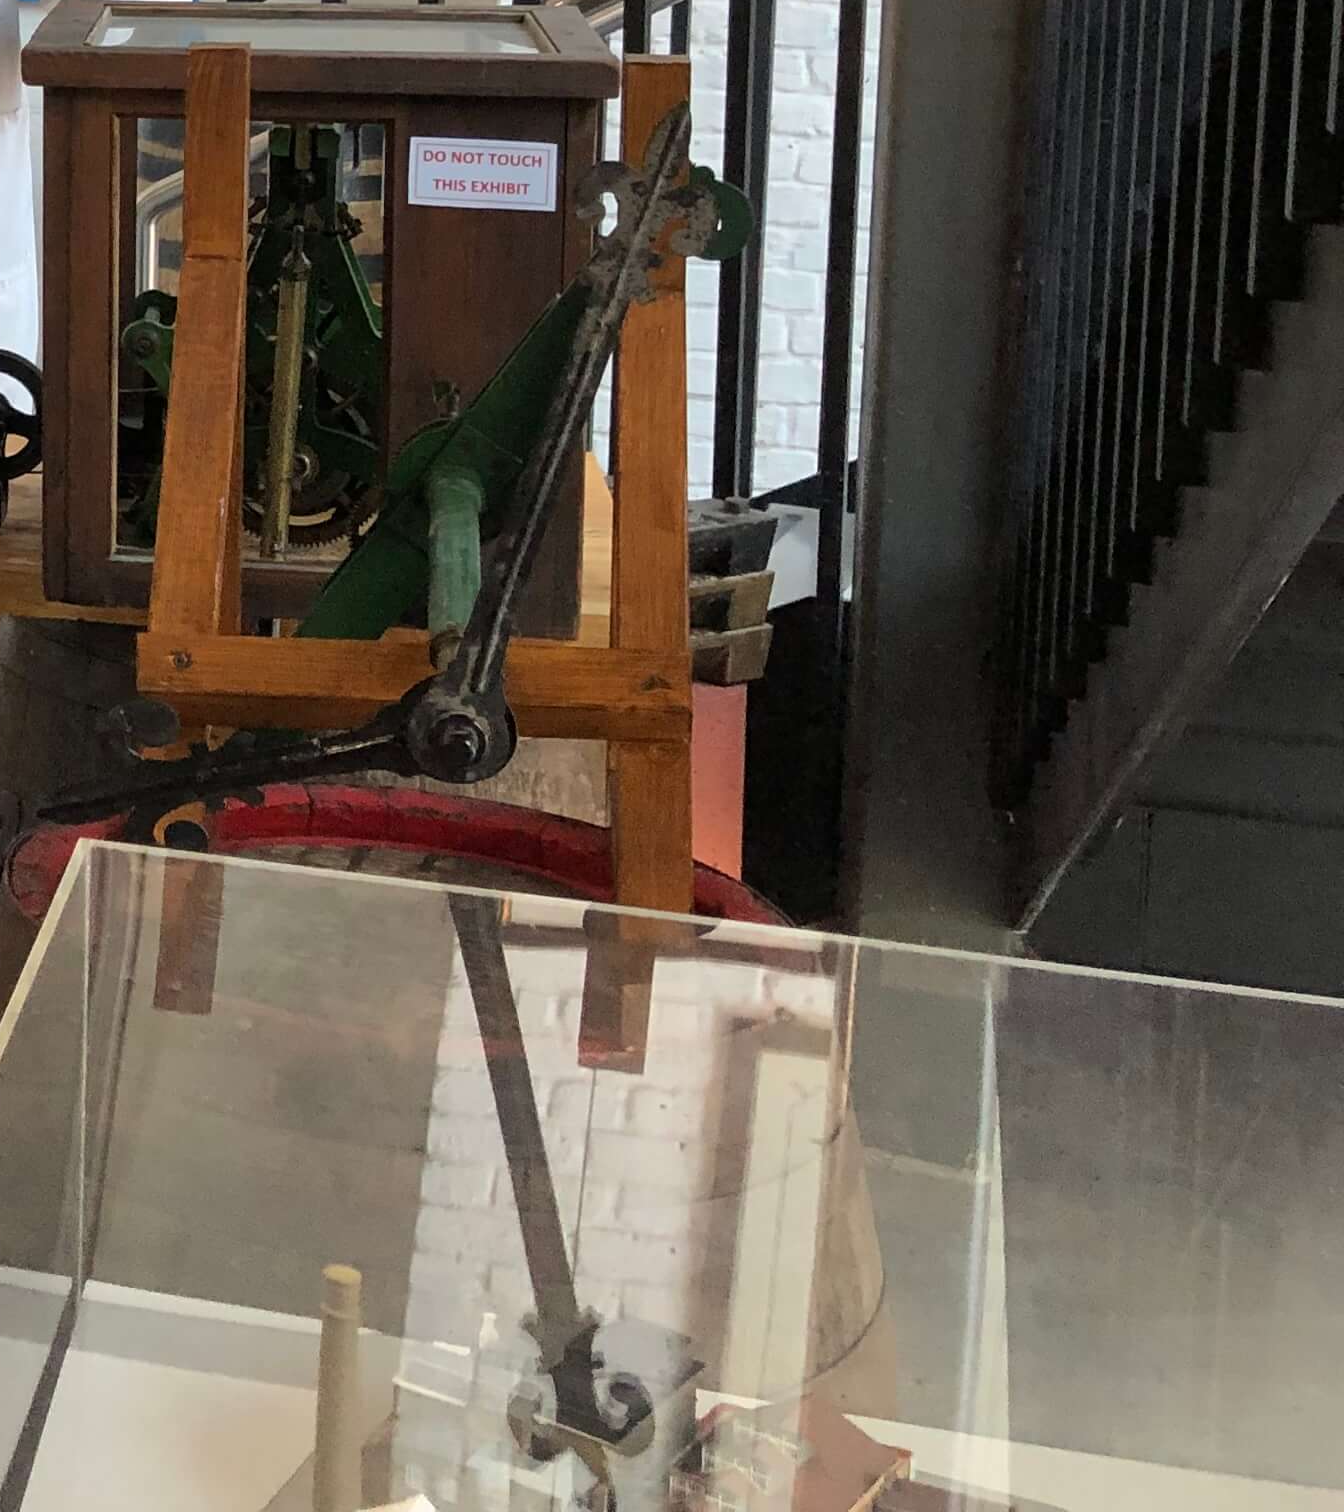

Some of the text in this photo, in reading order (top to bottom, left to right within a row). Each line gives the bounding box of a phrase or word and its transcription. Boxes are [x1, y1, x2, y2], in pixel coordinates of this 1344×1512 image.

[423, 150, 543, 168] DO NOT TOUCH
[432, 178, 531, 195] THIS EXHIBIT
